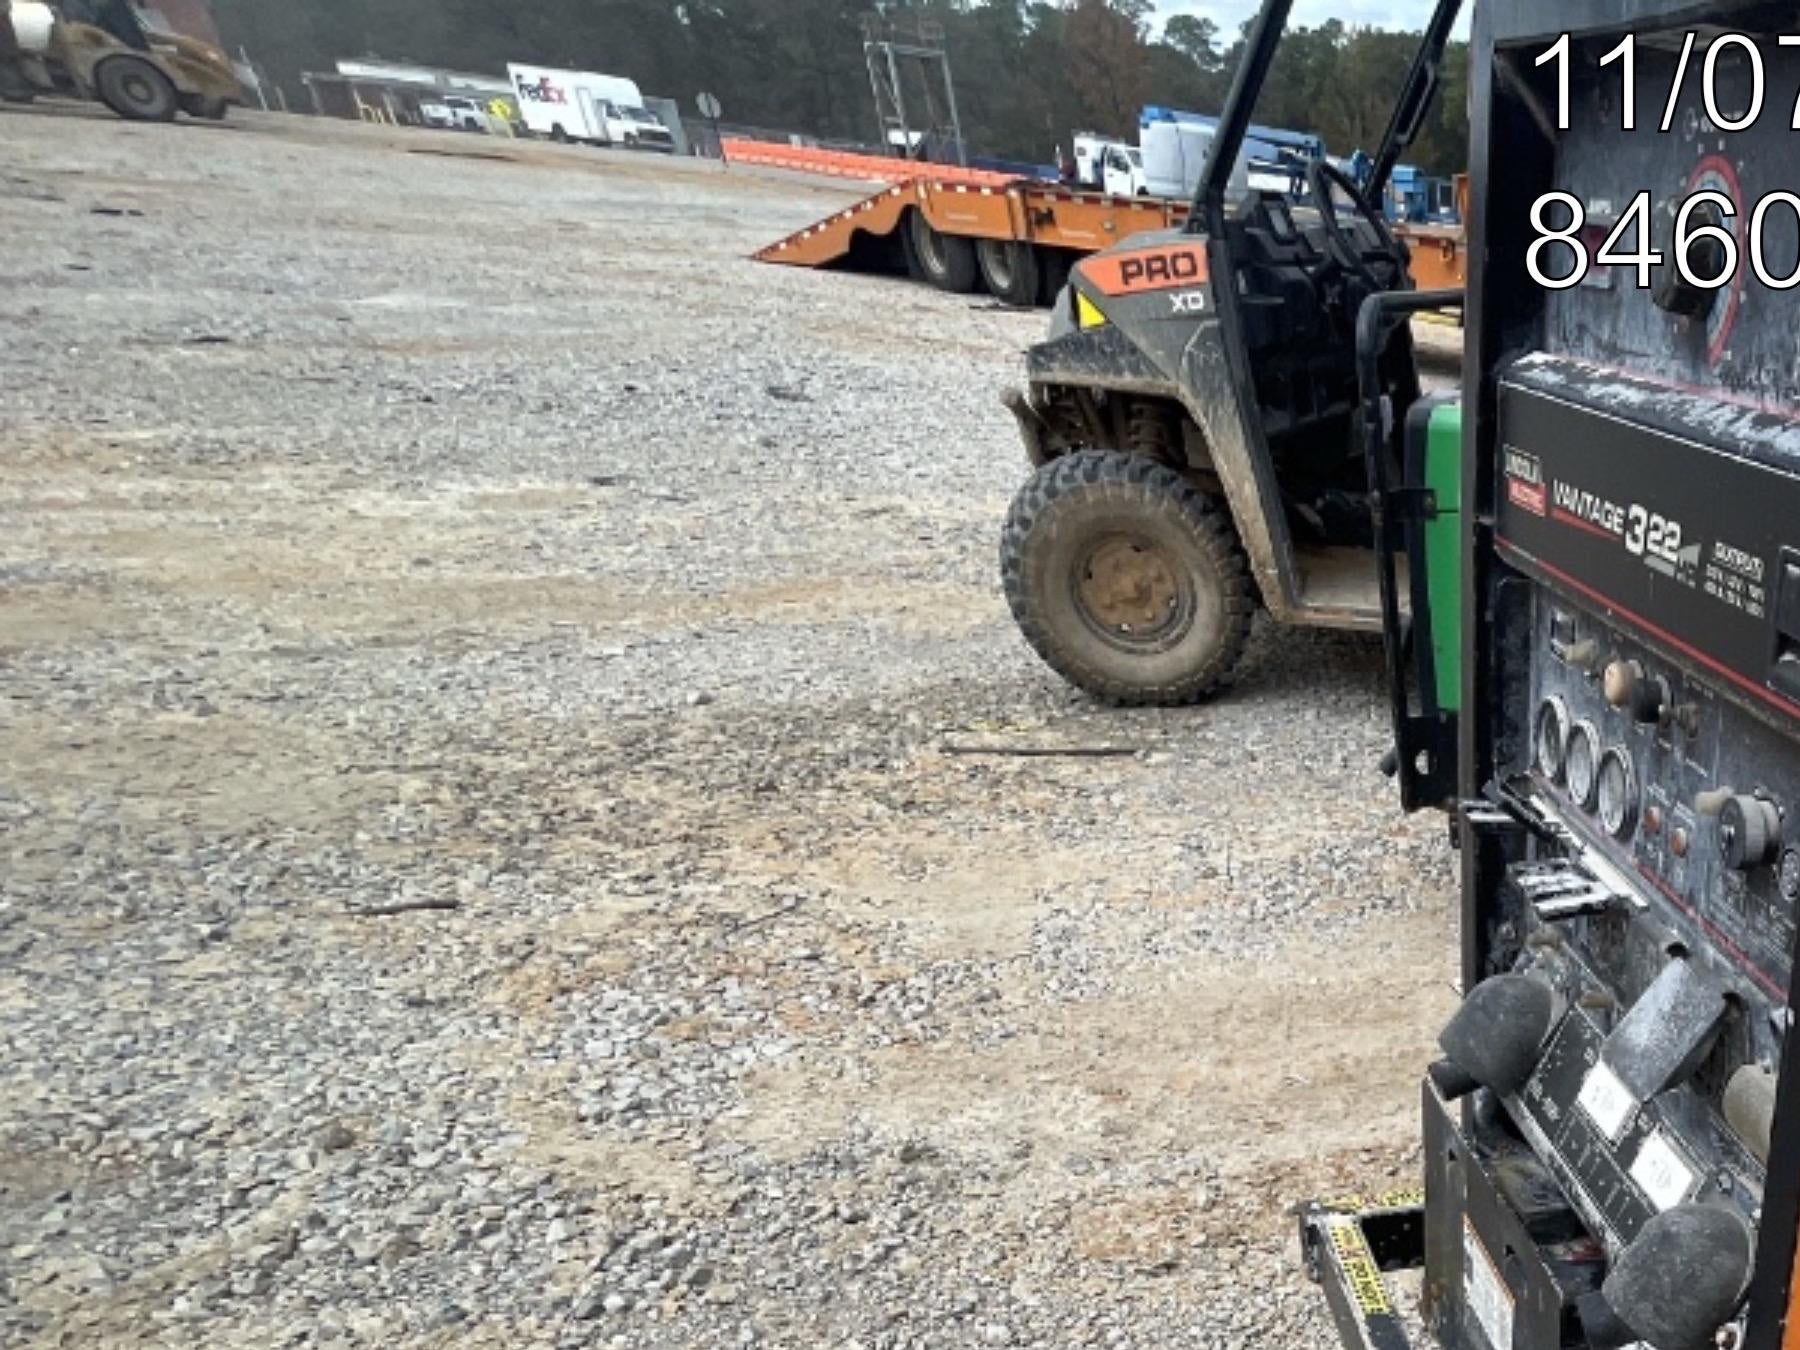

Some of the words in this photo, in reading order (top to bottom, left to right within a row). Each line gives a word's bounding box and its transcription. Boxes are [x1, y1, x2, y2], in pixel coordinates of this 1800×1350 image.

[1119, 251, 1197, 285] PRO
[1169, 291, 1204, 312] XD
[1553, 478, 1625, 535] VANTAGE
[1624, 503, 1681, 563] 322
